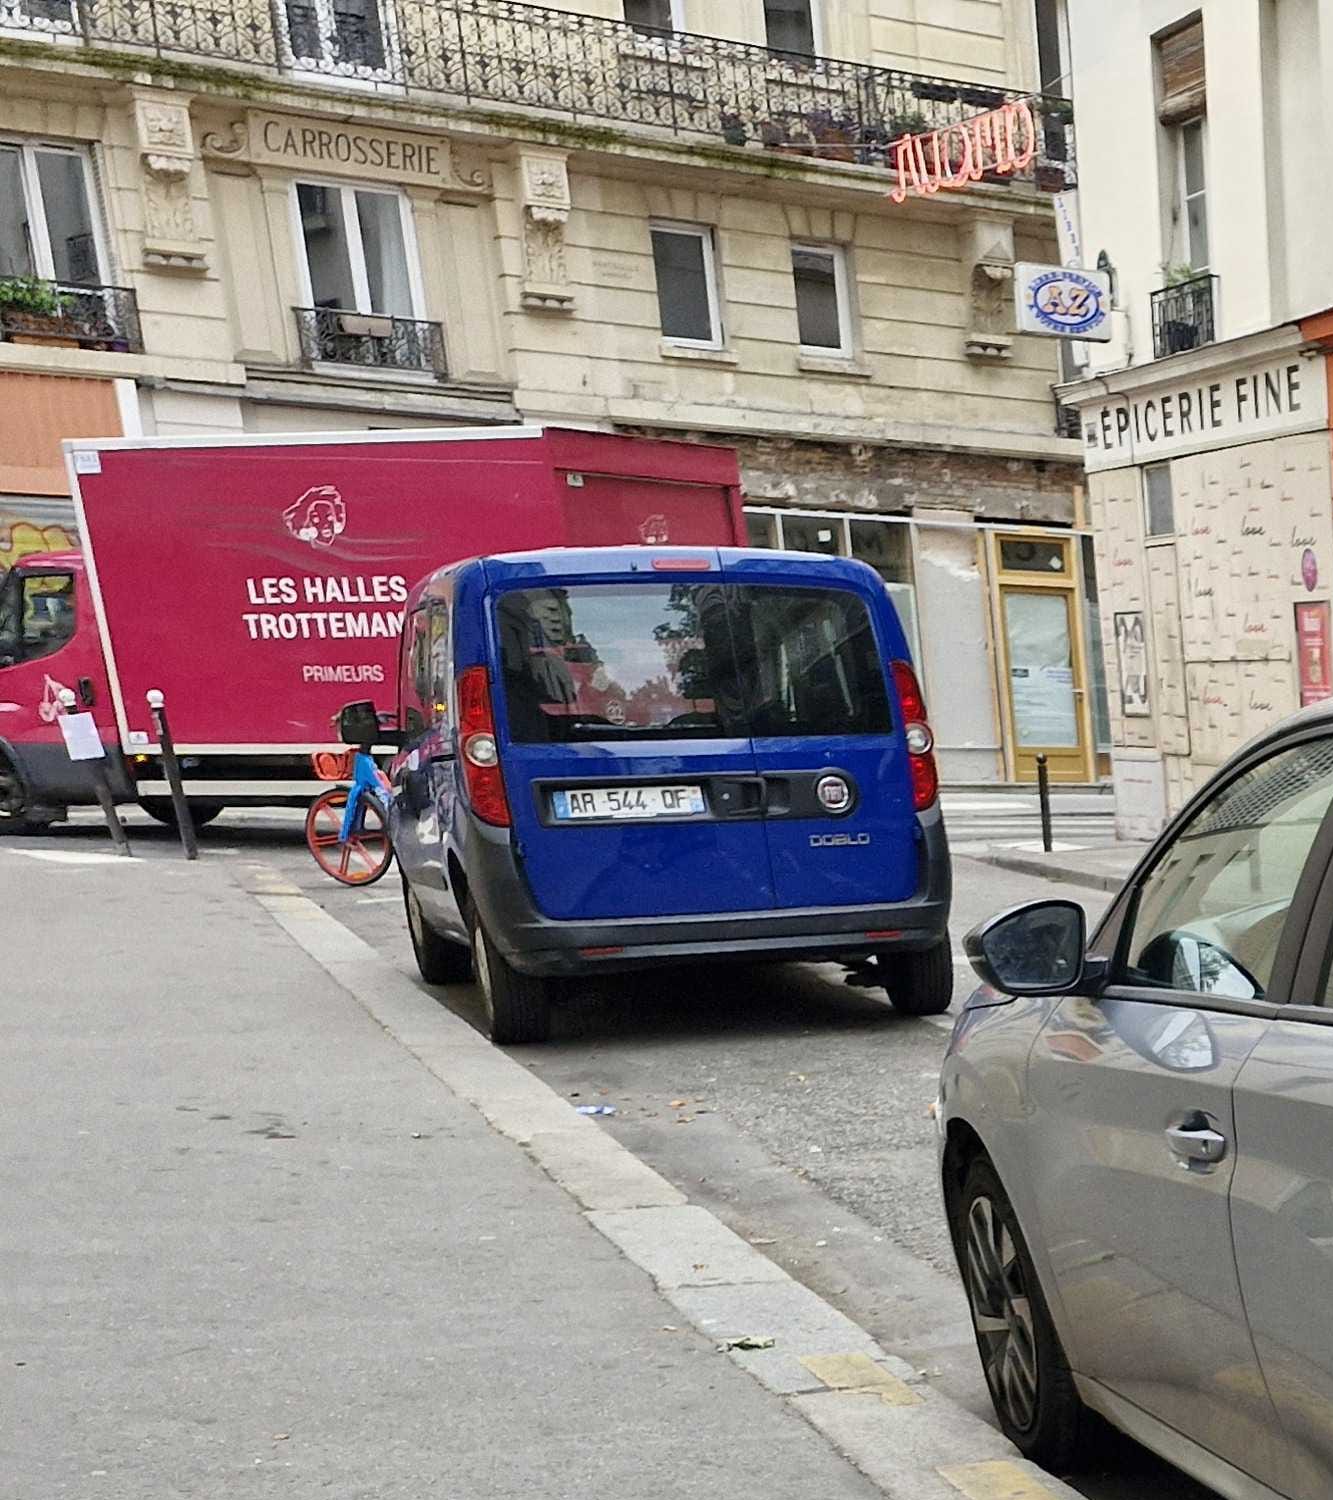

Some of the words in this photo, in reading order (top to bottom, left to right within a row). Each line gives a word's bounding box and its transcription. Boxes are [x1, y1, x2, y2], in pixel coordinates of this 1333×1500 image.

[263, 120, 441, 175] CARROSSERIE
[1043, 286, 1090, 317] AZ
[1100, 384, 1222, 449] ÉPICERIE
[1235, 364, 1302, 423] FINE
[247, 577, 297, 605] LES
[303, 575, 408, 604] HALLES
[303, 664, 385, 683] PRIMEURS
[809, 832, 870, 847] DOBLO
